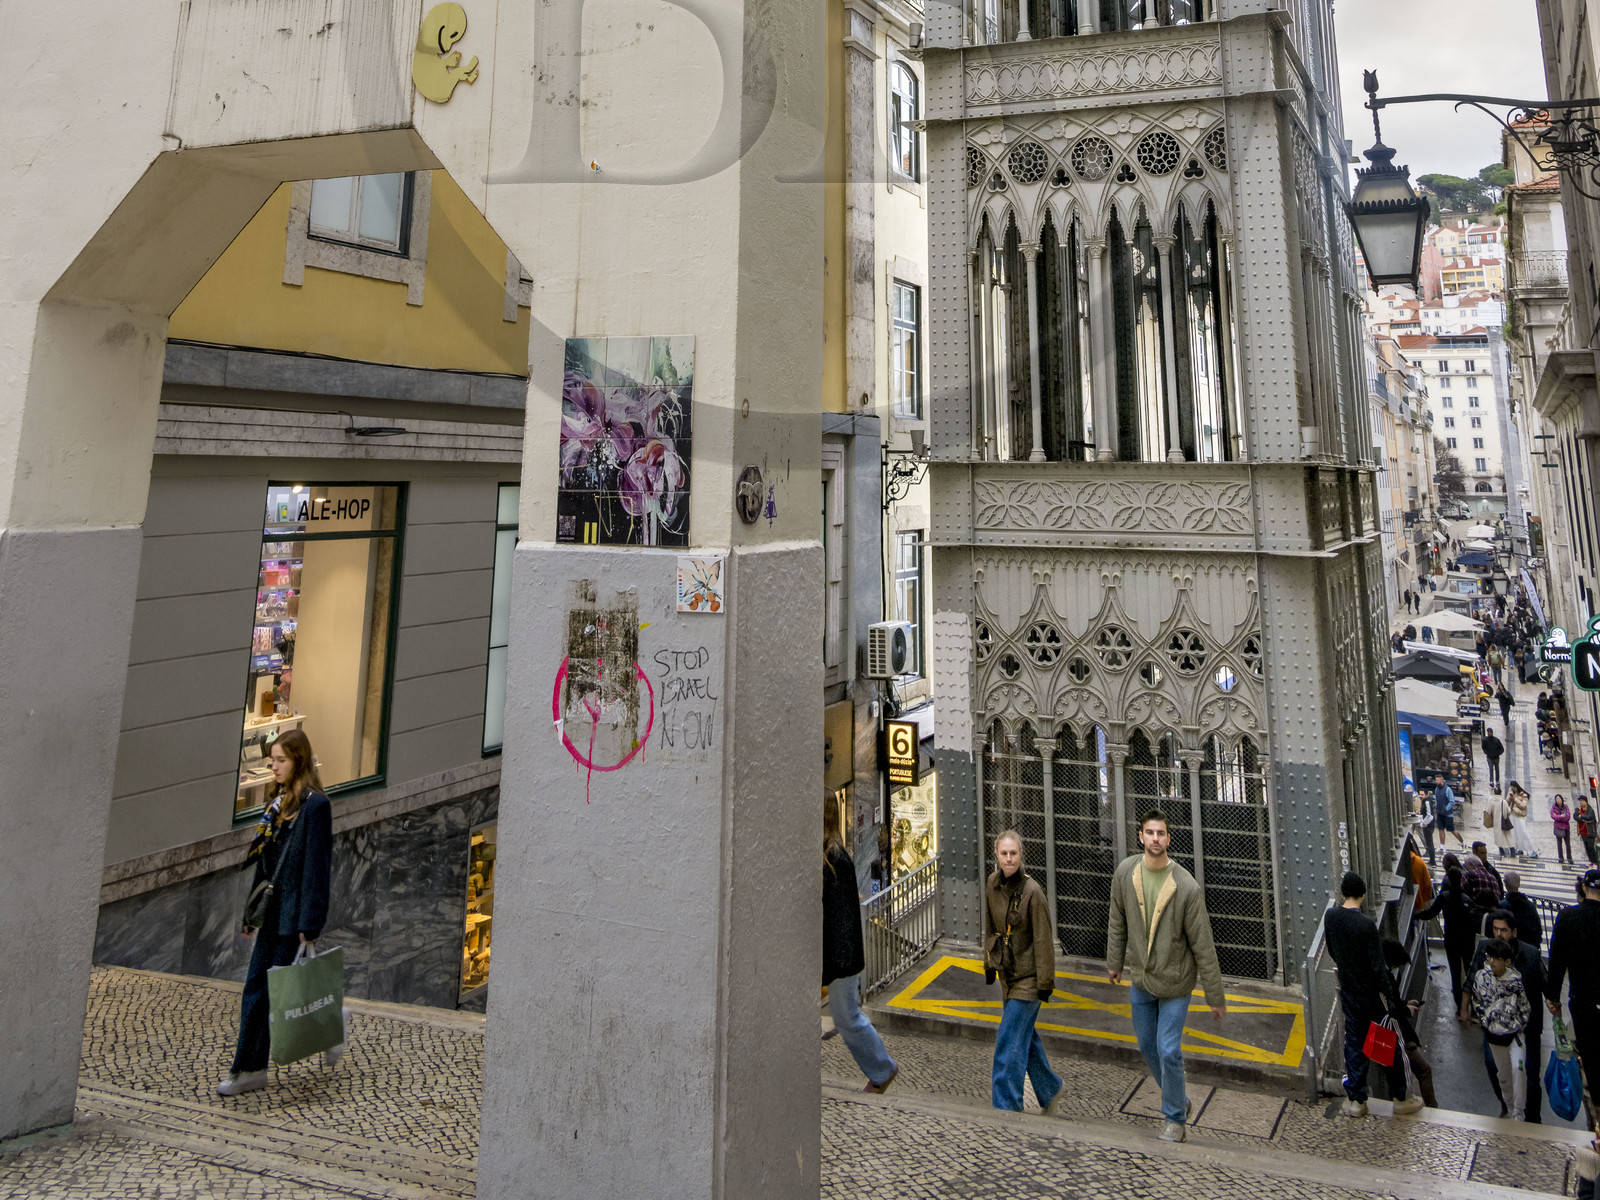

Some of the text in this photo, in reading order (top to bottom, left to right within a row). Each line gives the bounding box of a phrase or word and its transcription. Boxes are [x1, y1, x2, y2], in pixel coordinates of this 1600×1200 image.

[298, 499, 371, 521] ALE-HOP
[654, 647, 710, 677] STOP
[660, 676, 717, 707] ISRAEL
[660, 702, 716, 749] NOW
[893, 728, 909, 755] 6
[285, 994, 334, 1020] PULL&BEAR
